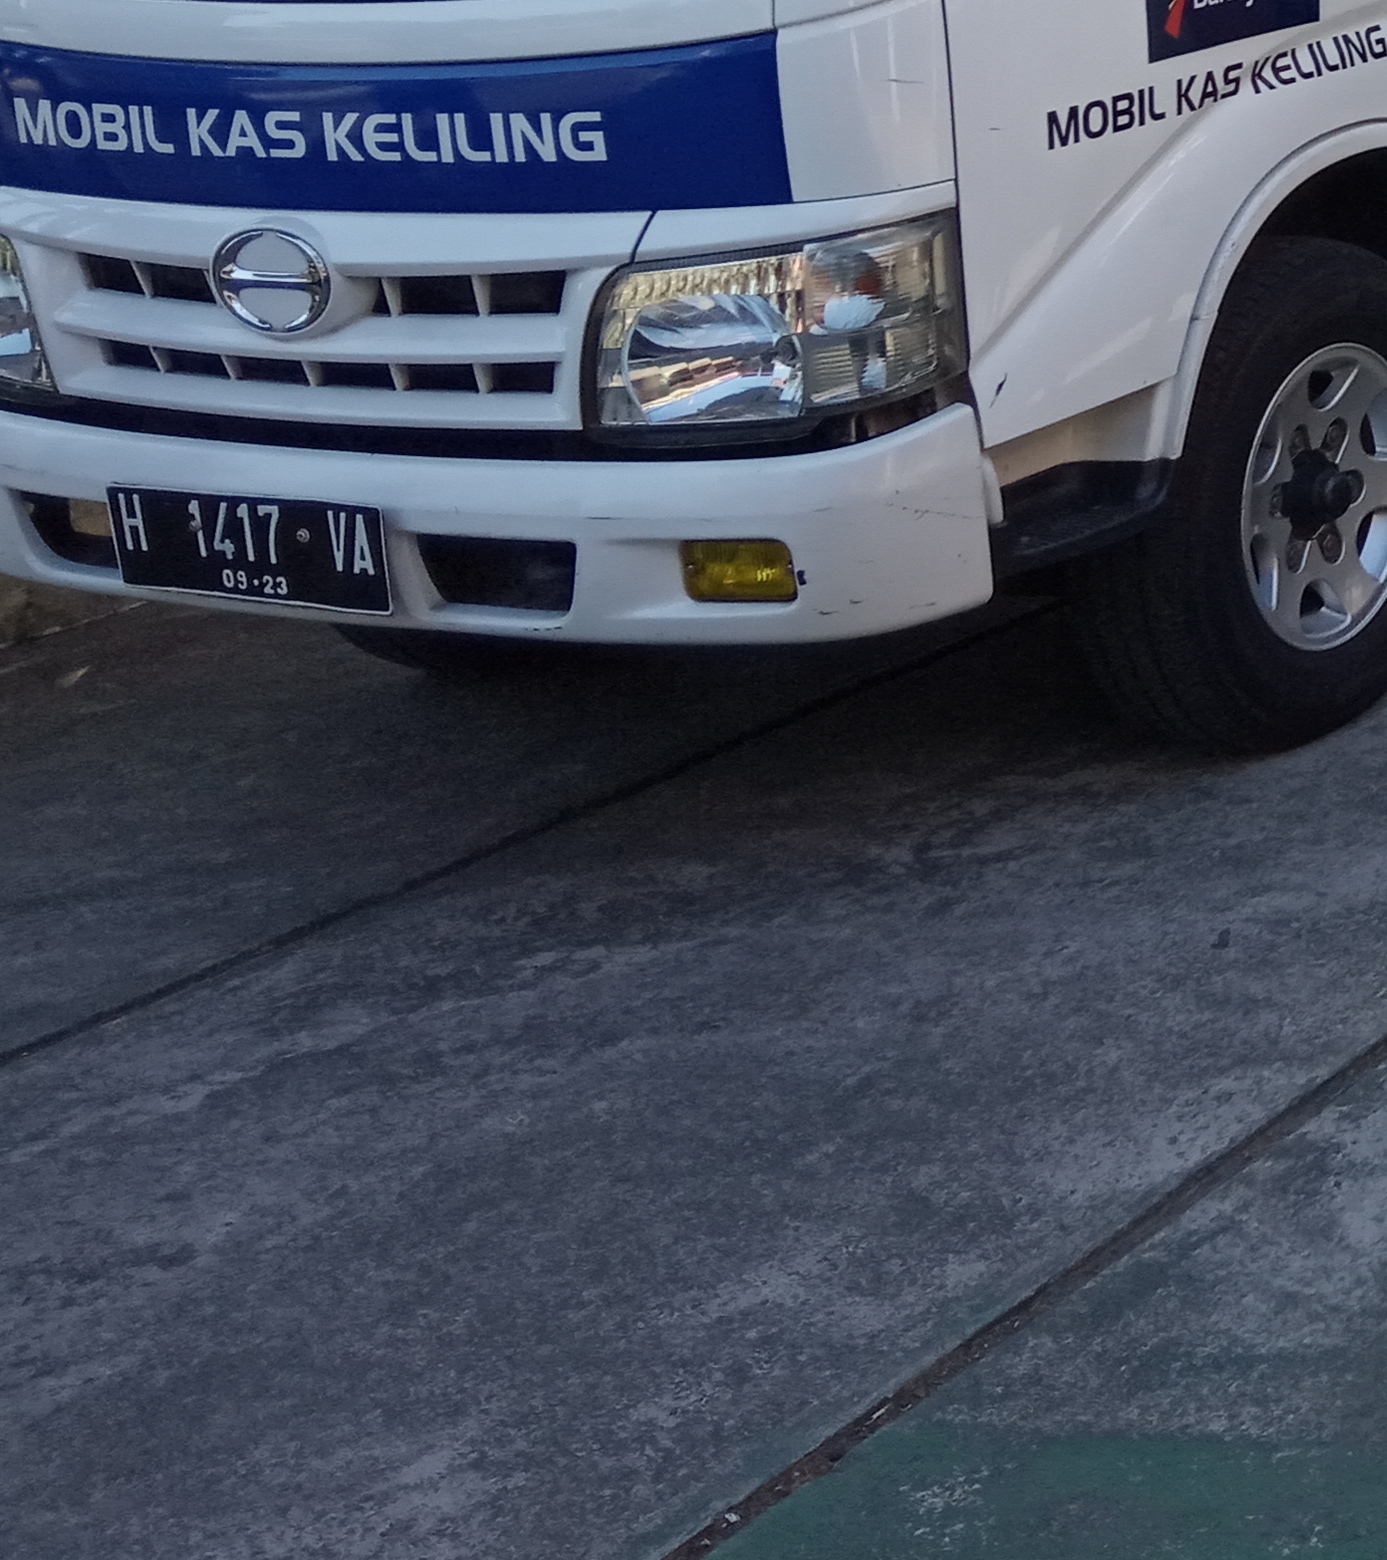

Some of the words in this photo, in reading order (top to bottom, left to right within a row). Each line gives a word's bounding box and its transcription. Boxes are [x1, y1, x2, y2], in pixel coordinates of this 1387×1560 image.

[13, 96, 175, 155] MOBIL
[186, 107, 306, 159] KAS
[322, 110, 608, 164] KELILING
[1046, 89, 1167, 151] MOBIL
[1175, 62, 1244, 117] KAS
[118, 492, 148, 552] H
[188, 499, 279, 565] 1417
[327, 509, 376, 576] VA
